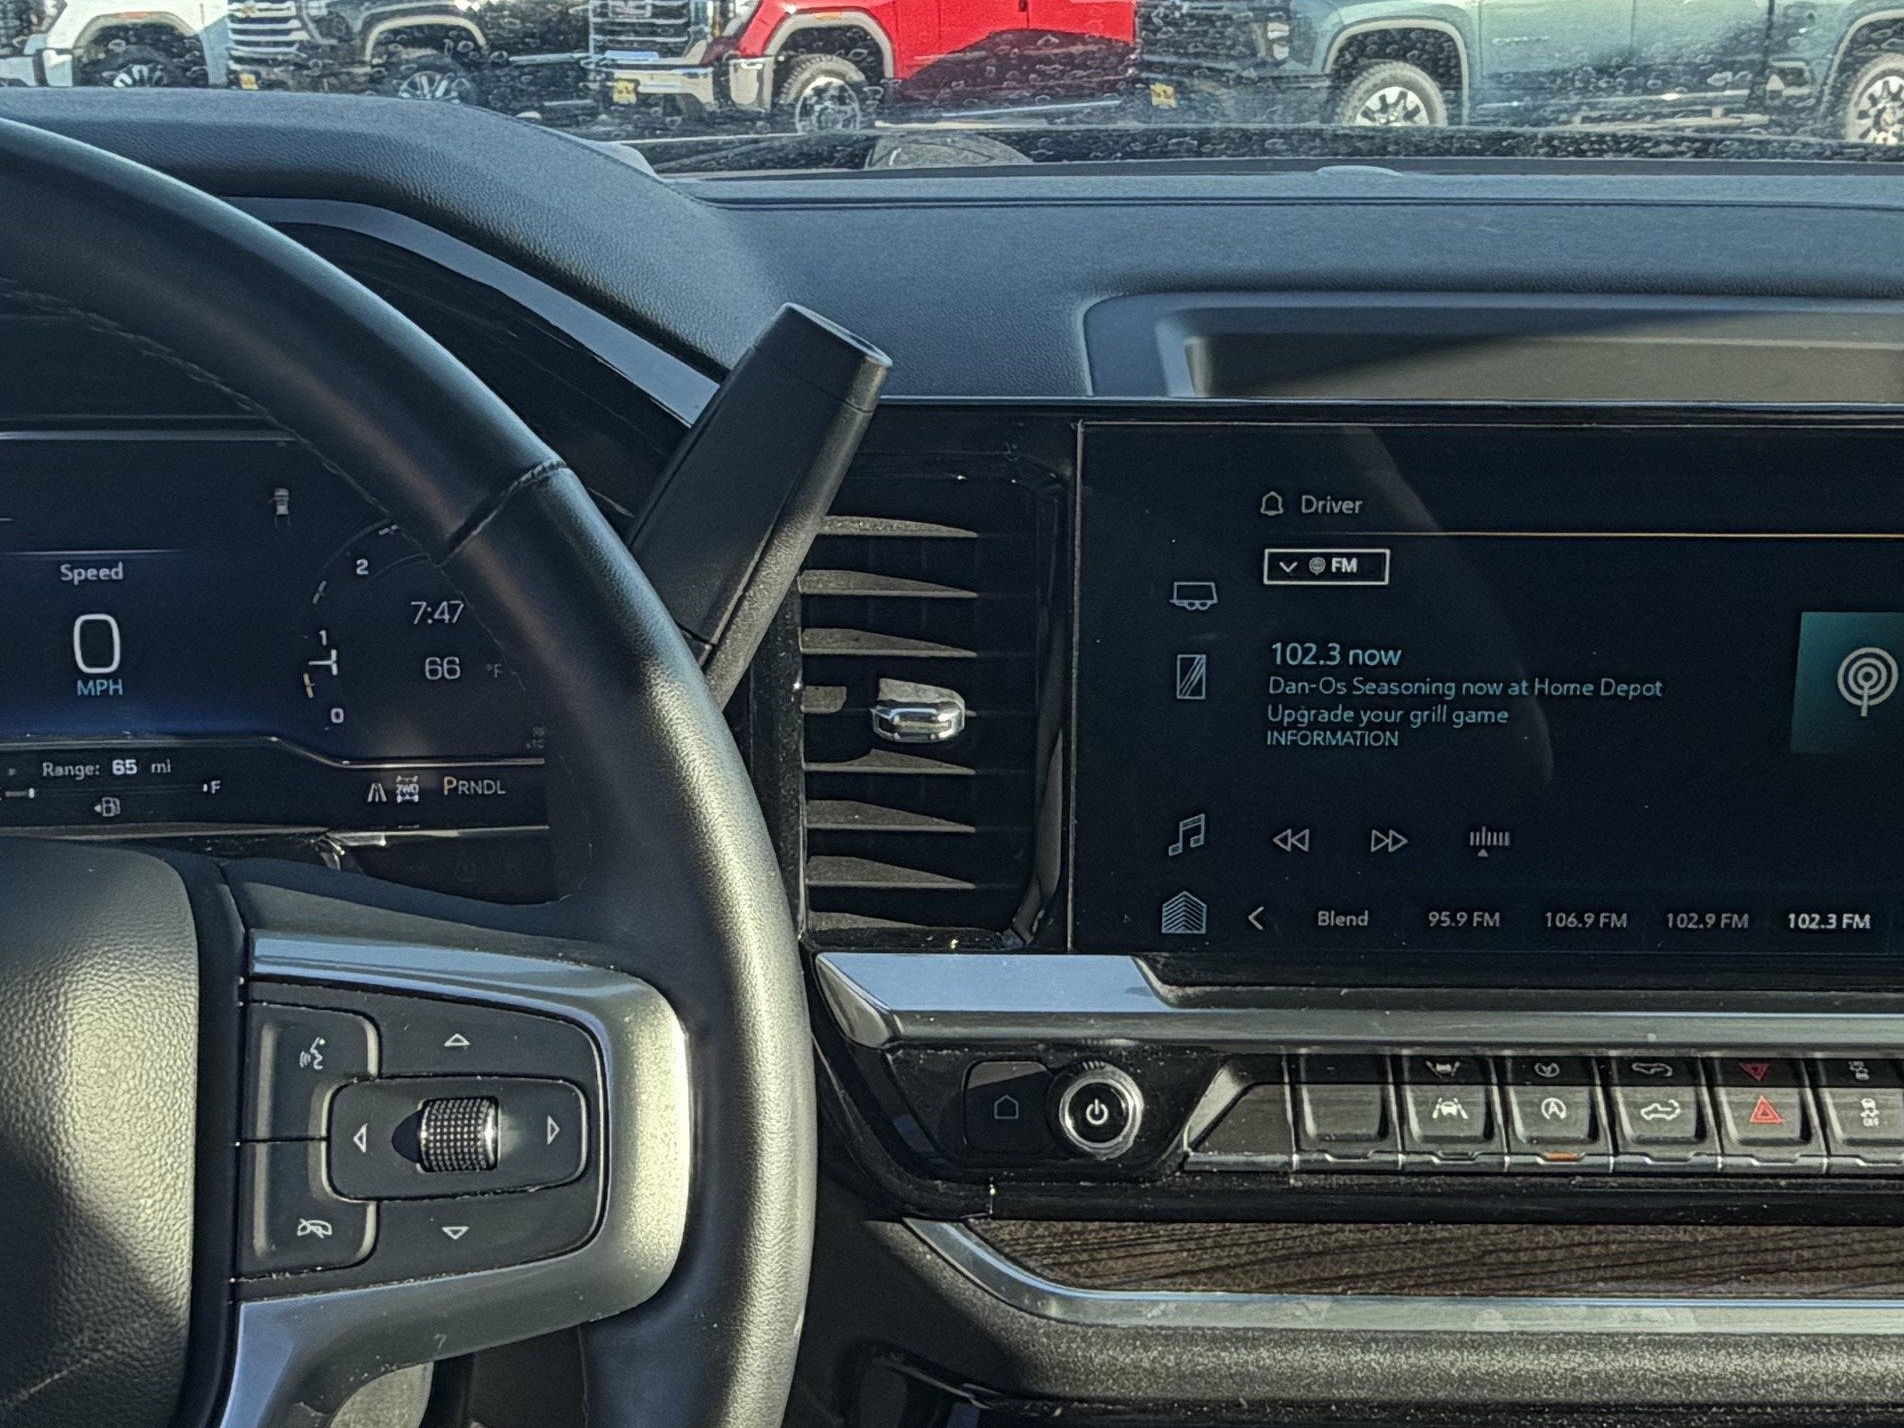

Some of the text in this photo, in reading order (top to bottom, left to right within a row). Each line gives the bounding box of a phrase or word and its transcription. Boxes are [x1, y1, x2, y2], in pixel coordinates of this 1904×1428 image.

[1302, 495, 1362, 513] Driver
[356, 559, 368, 575] 2
[1332, 558, 1357, 572] FM
[61, 562, 123, 585] Speed
[411, 600, 464, 624] 7:47
[74, 614, 120, 673] 0
[320, 630, 327, 645] 1
[1272, 643, 1401, 665] 102.3 now
[424, 657, 461, 680] 66
[77, 679, 123, 695] MPH
[1269, 676, 1662, 700] Dan-Os Seasoning now at Home Depot
[331, 708, 344, 723] 0
[1268, 704, 1508, 728] Upgrade your grill game
[1267, 730, 1398, 746] INFORMATION
[43, 759, 171, 780] Range: 65 mi
[210, 780, 221, 796] F
[1318, 911, 1368, 926] Blend
[1429, 912, 1499, 927] 95.9 FM
[1546, 912, 1627, 927] 106.9 FM
[1668, 913, 1748, 928] 102.9 FM
[1789, 914, 1870, 929] 102.3 FM
